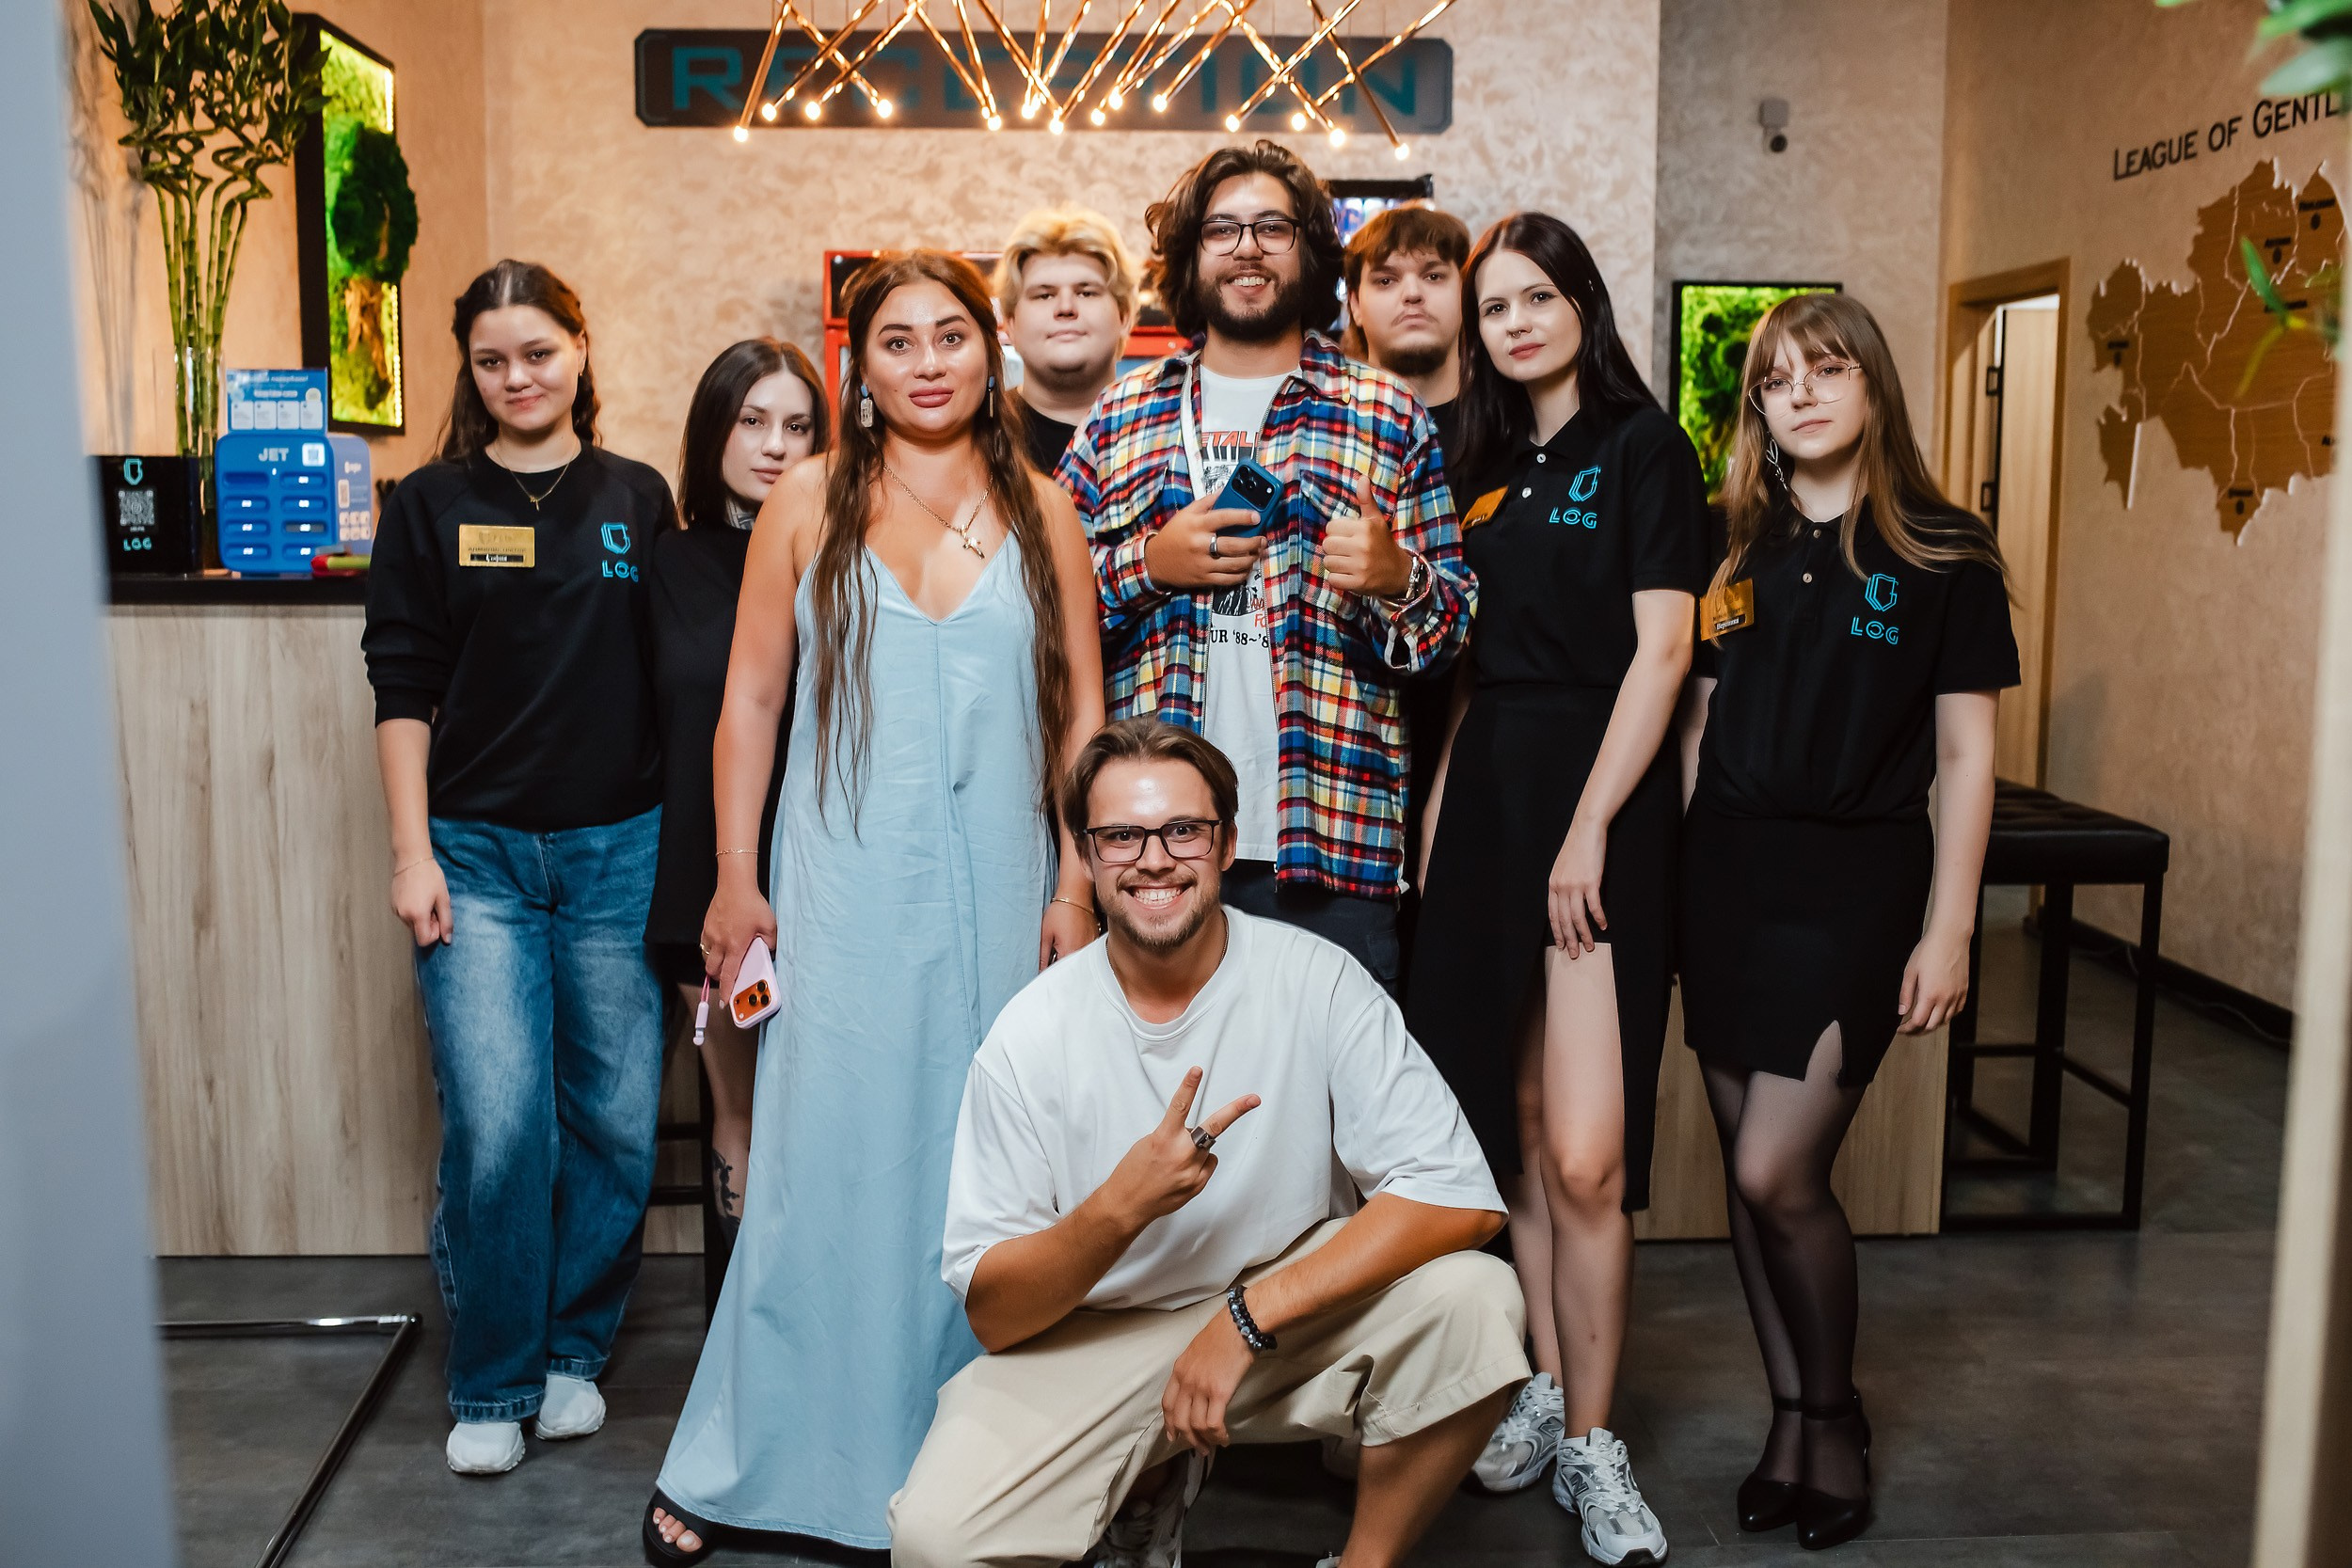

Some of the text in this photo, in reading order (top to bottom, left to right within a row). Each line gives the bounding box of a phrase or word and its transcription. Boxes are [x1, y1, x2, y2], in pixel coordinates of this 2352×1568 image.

[258, 447, 290, 462] JET
[1549, 506, 1597, 530] LOG
[123, 537, 151, 552] LOG
[1851, 615, 1899, 645] LOG
